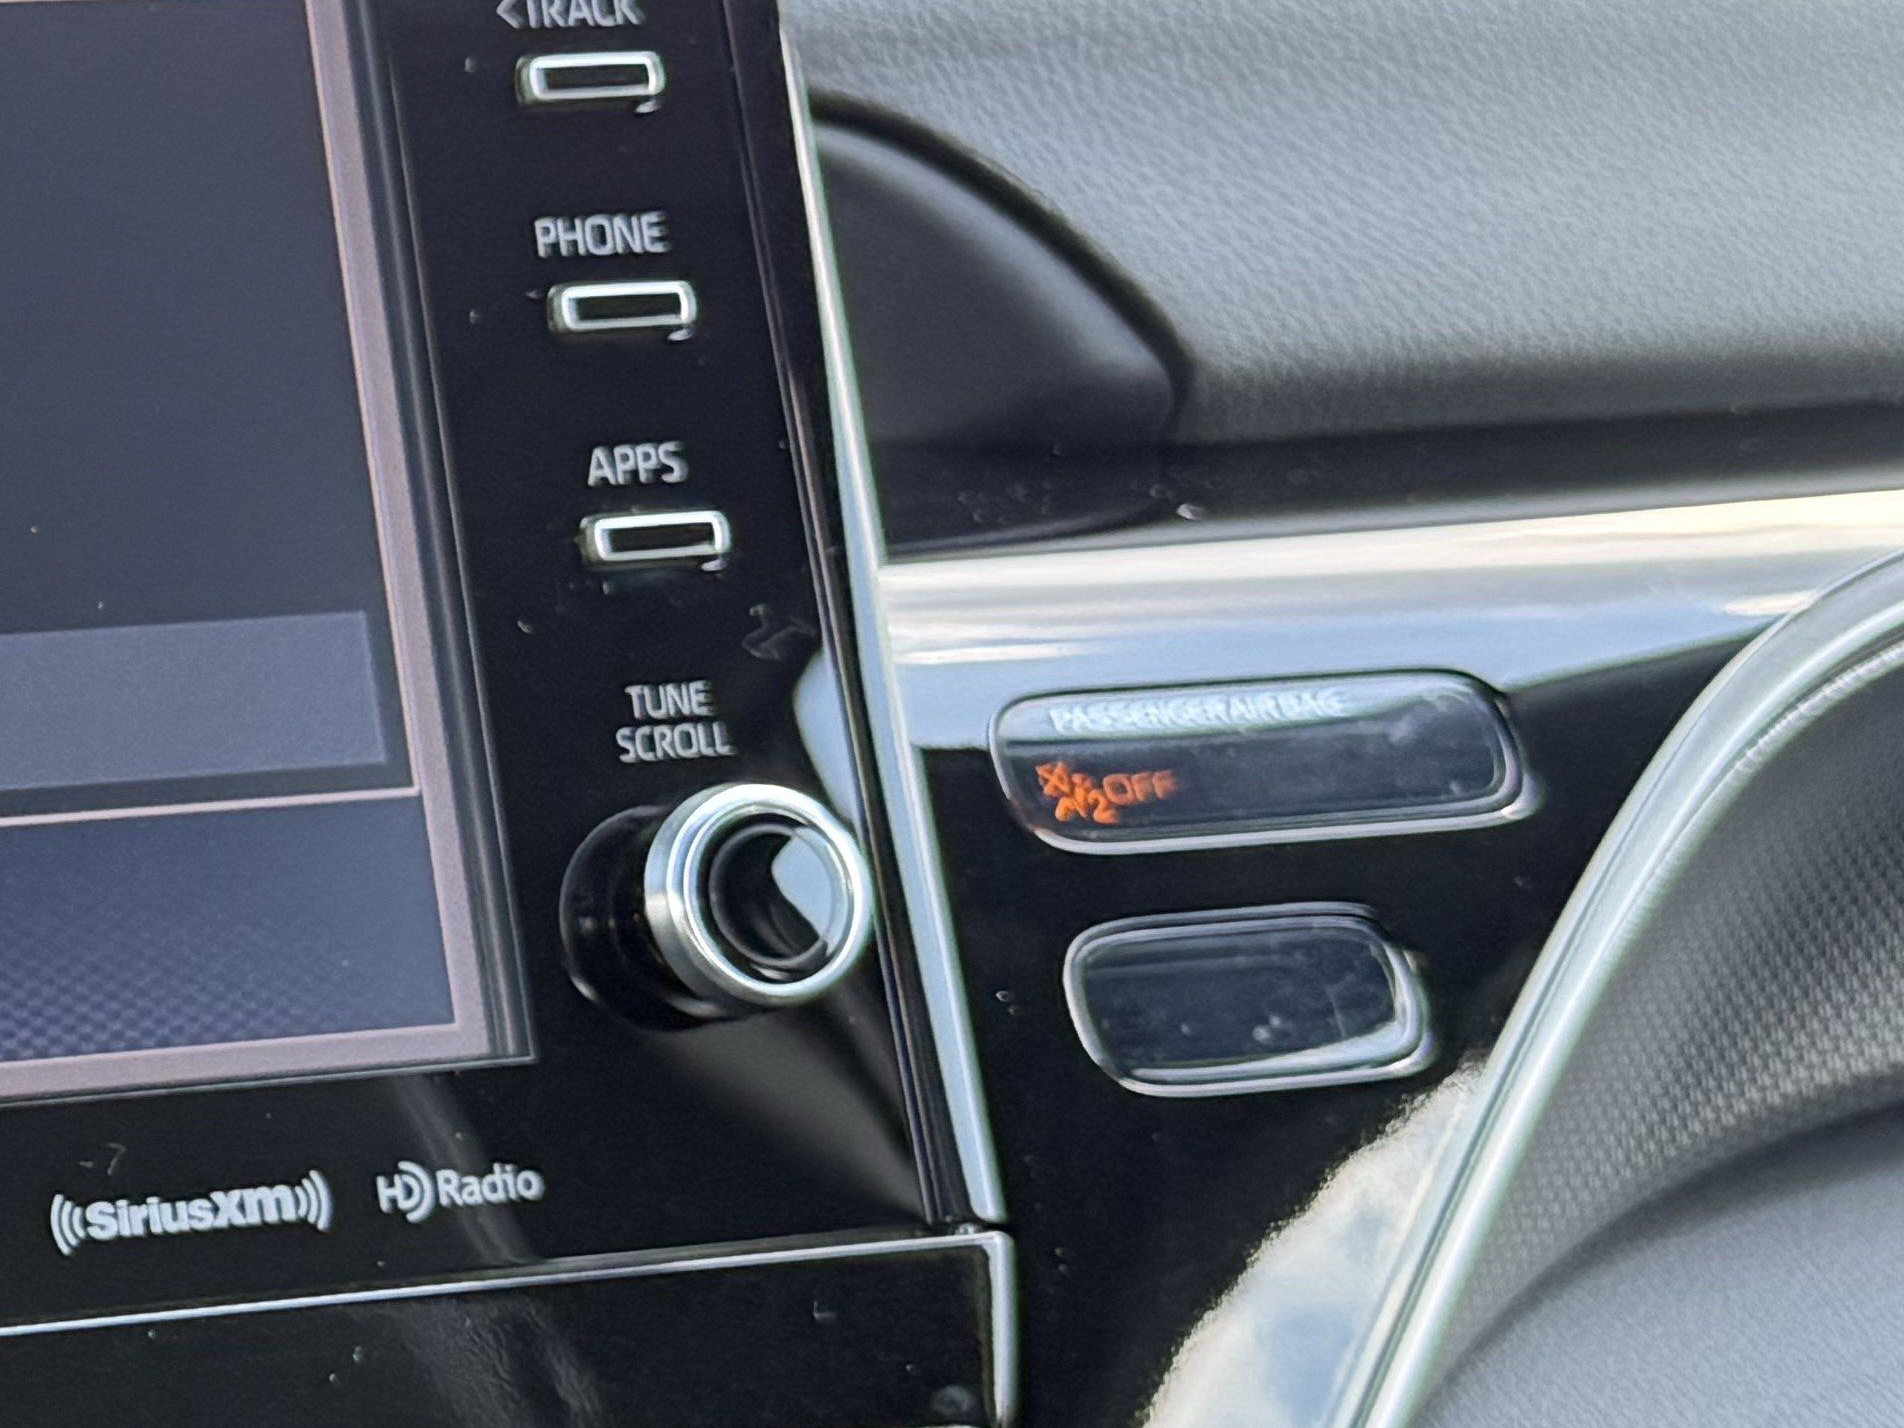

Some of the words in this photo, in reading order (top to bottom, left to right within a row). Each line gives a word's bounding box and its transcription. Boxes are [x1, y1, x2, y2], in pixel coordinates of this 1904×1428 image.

[534, 211, 666, 257] PHONE
[587, 441, 685, 486] APPS
[625, 680, 711, 719] TUNE
[615, 721, 733, 763] SCROLL
[1102, 771, 1176, 807] OFF
[376, 1168, 423, 1220] HD
[435, 1162, 543, 1207] Radio
